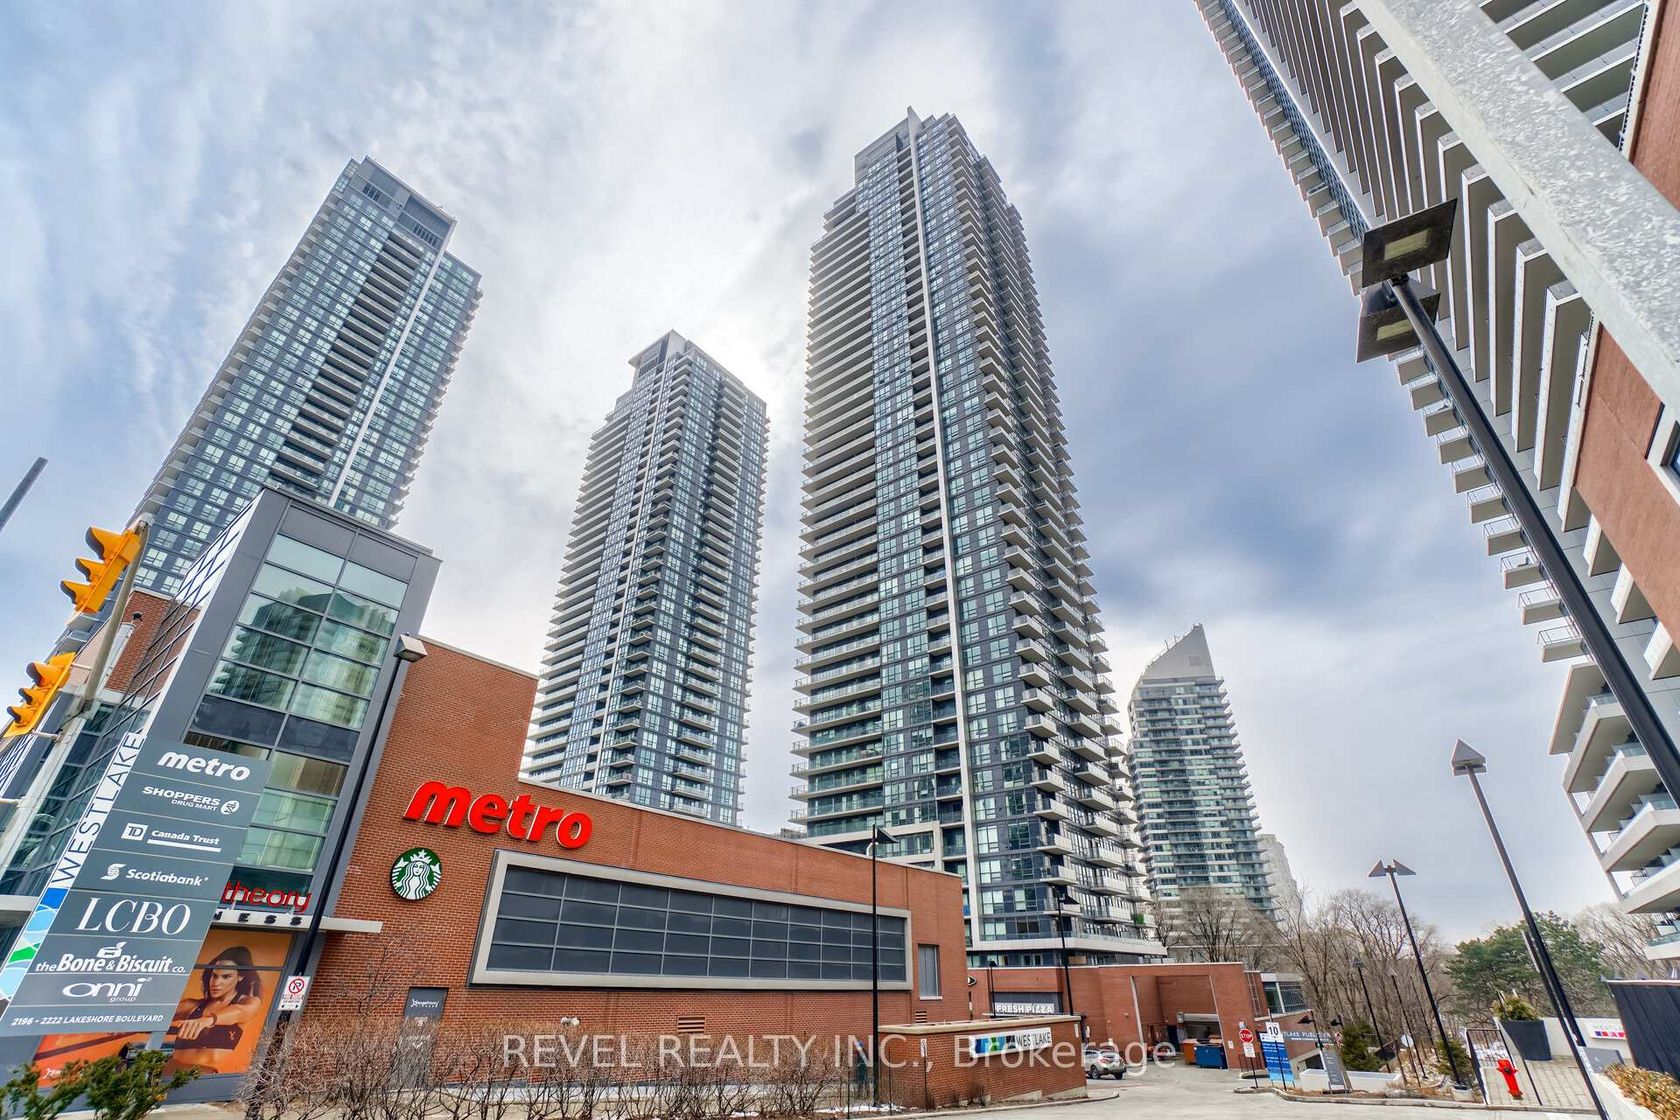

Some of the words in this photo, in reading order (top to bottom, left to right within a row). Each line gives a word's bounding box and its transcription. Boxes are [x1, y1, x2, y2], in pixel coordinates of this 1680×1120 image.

[157, 751, 251, 781] metro
[142, 786, 221, 807] SHOPPERS
[171, 799, 194, 808] DRUG
[195, 803, 218, 811] MART
[52, 735, 145, 884] WESTLAKE
[403, 780, 593, 849] metro
[151, 830, 190, 841] Canada
[193, 835, 220, 845] Trust
[126, 869, 203, 886] Scotiabank
[221, 881, 312, 915] theory
[75, 897, 191, 935] LCBO
[35, 962, 56, 972] the
[56, 953, 105, 972] Bone
[106, 960, 116, 971] &
[115, 955, 173, 973] Biscuit
[62, 977, 147, 998] onni
[995, 1003, 1025, 1014] FRESH
[1025, 1003, 1055, 1014] PIZZA
[11, 1017, 34, 1026] 2196
[40, 1016, 63, 1025] 2222
[63, 1015, 113, 1024] LAKESHORE
[117, 1014, 164, 1023] BOULEVARD
[1269, 1026, 1279, 1035] 10
